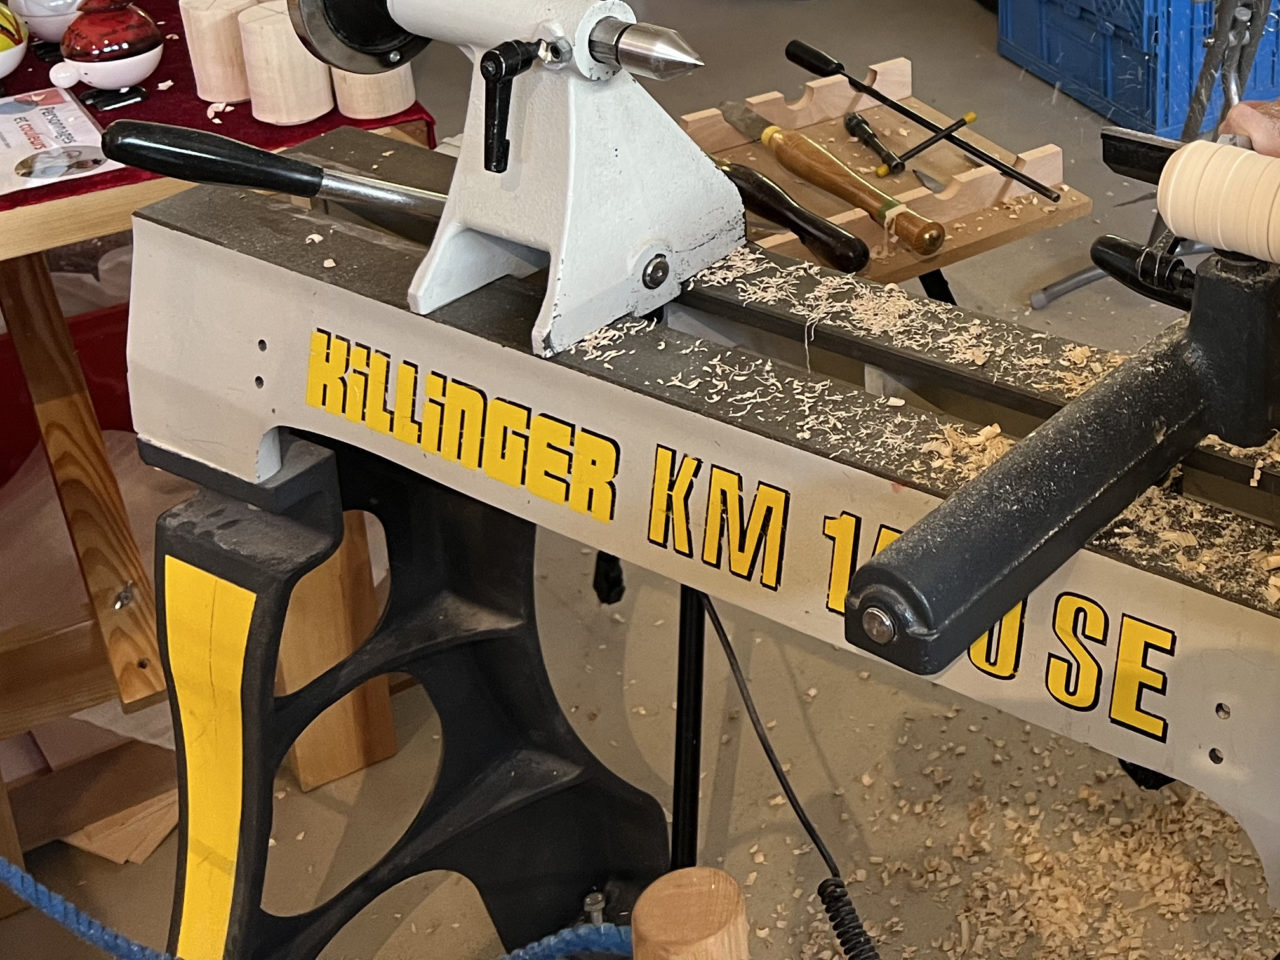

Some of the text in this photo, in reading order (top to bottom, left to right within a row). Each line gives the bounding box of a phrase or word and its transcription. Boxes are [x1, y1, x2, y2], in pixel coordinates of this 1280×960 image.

[19, 122, 48, 151] couleurs
[39, 106, 77, 145] Personnages
[647, 443, 790, 592] KM
[1045, 591, 1177, 745] SE
